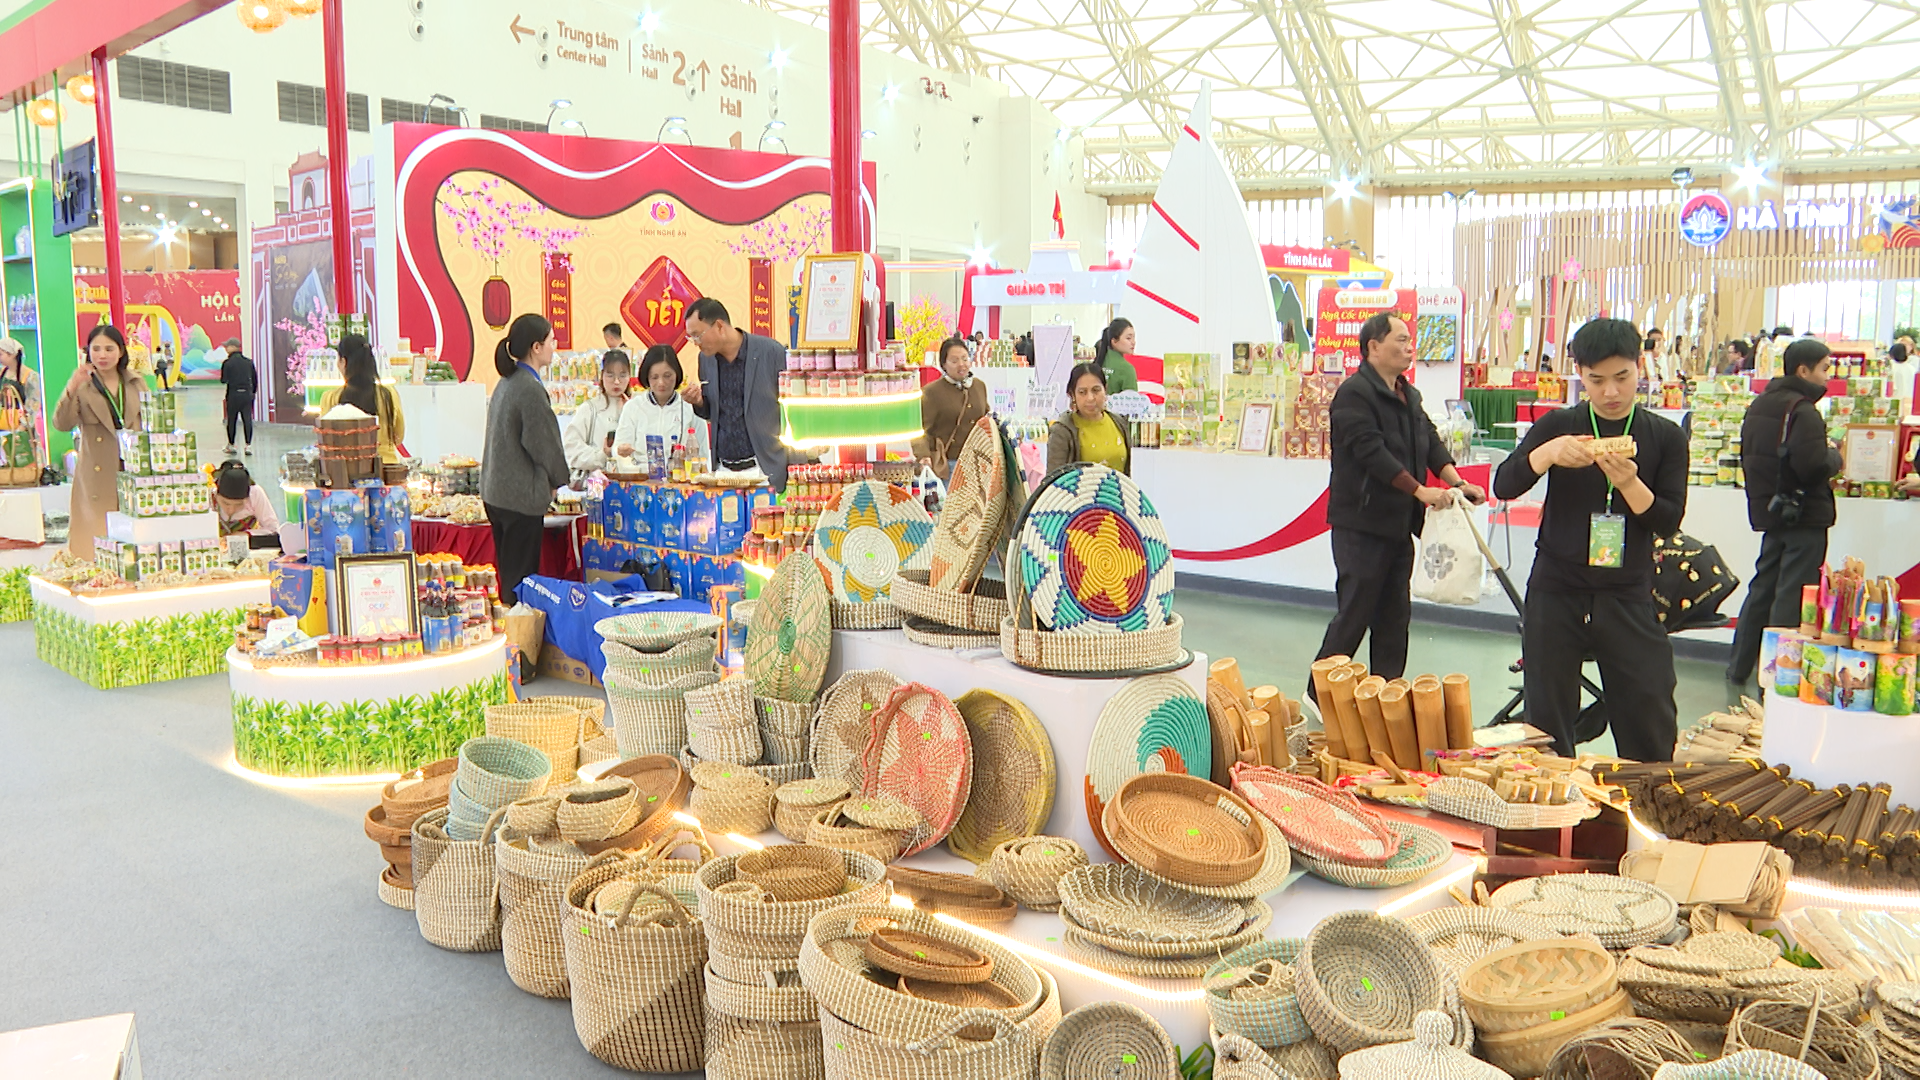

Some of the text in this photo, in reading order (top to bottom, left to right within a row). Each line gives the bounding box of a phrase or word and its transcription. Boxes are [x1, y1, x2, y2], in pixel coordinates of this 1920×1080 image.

[557, 20, 619, 51] Trung tâm
[557, 45, 607, 68] Center Hall
[642, 43, 686, 86] Sảnh 2
[642, 66, 658, 80] Hall
[720, 64, 757, 94] Sảnh
[720, 96, 742, 118] Hall
[1736, 199, 1779, 231] HÀ
[1006, 279, 1066, 298] QUẢNG TRỊ
[200, 291, 229, 310] HỘI
[646, 285, 684, 328] TẾT
[1418, 294, 1440, 307] GHỆ
